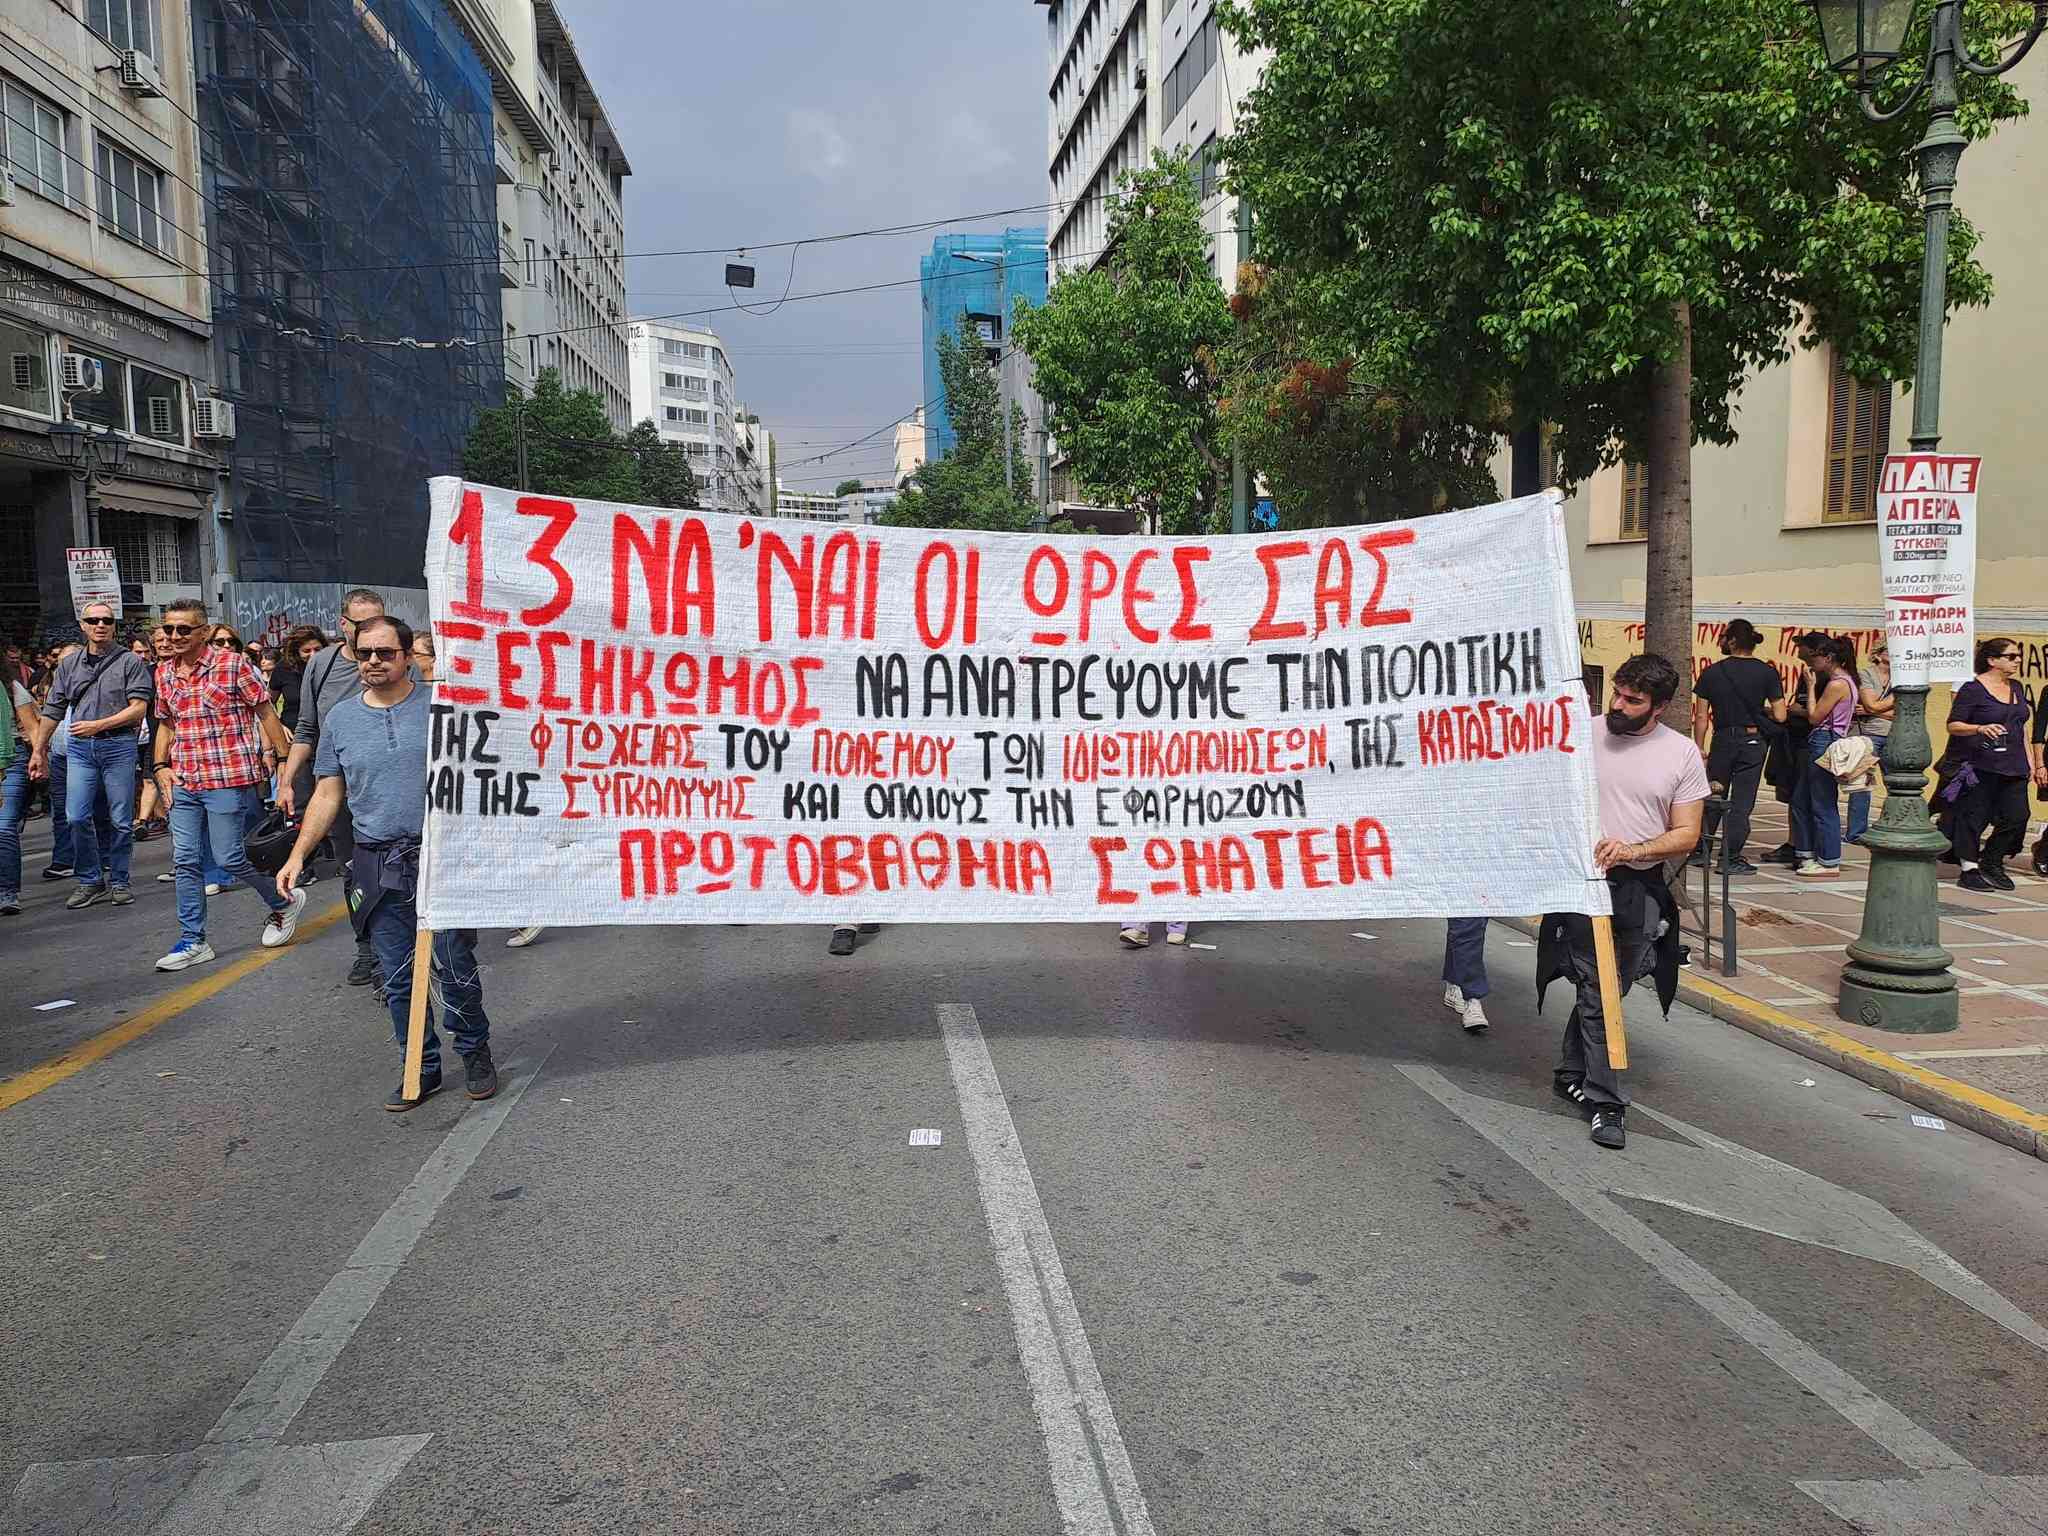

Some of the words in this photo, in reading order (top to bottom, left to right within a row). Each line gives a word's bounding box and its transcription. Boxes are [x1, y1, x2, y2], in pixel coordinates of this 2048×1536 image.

[449, 490, 578, 627] 13
[611, 512, 716, 638] ΝΑ
[914, 540, 980, 651] ΟΙ
[1023, 543, 1214, 646] ΩΡΕΣ
[1247, 527, 1417, 644] ΣΑΣ
[434, 621, 826, 728] ΞΕΣΗΚΩΜΟΣ
[855, 653, 909, 719] ΝΑ
[922, 653, 1249, 721] ΑΝΑΤΡΕΨΟΥΜΕ
[1266, 647, 1350, 712] ΤΗΝ
[1361, 628, 1546, 704] ΠΟΛΙΤΙΚΗ
[430, 704, 500, 764] ΤΗΣ
[719, 724, 790, 773] ΤΟΥ
[811, 728, 955, 782] ΠΟΛΕΜΟΥ
[974, 730, 1045, 782] ΤΩΝ
[1345, 715, 1404, 769] ΤΗΣ
[1417, 695, 1575, 767] ΚΑΤΑΣΤΟΛΗΣ
[474, 769, 541, 817] ΤΗΣ
[783, 781, 840, 821] ΚΑΙ
[864, 782, 990, 825] ΟΠΟΙΟΥΣ
[1006, 787, 1074, 830] ΤΗΝ
[1096, 780, 1306, 827] ΕΦΑΡΜΟΖΟΥΝ
[619, 828, 1053, 901] ΠΡΩΤΟΒΑΘΜΙΑ
[1089, 817, 1394, 906] ΣΩΜΑΤΕΙΑ
